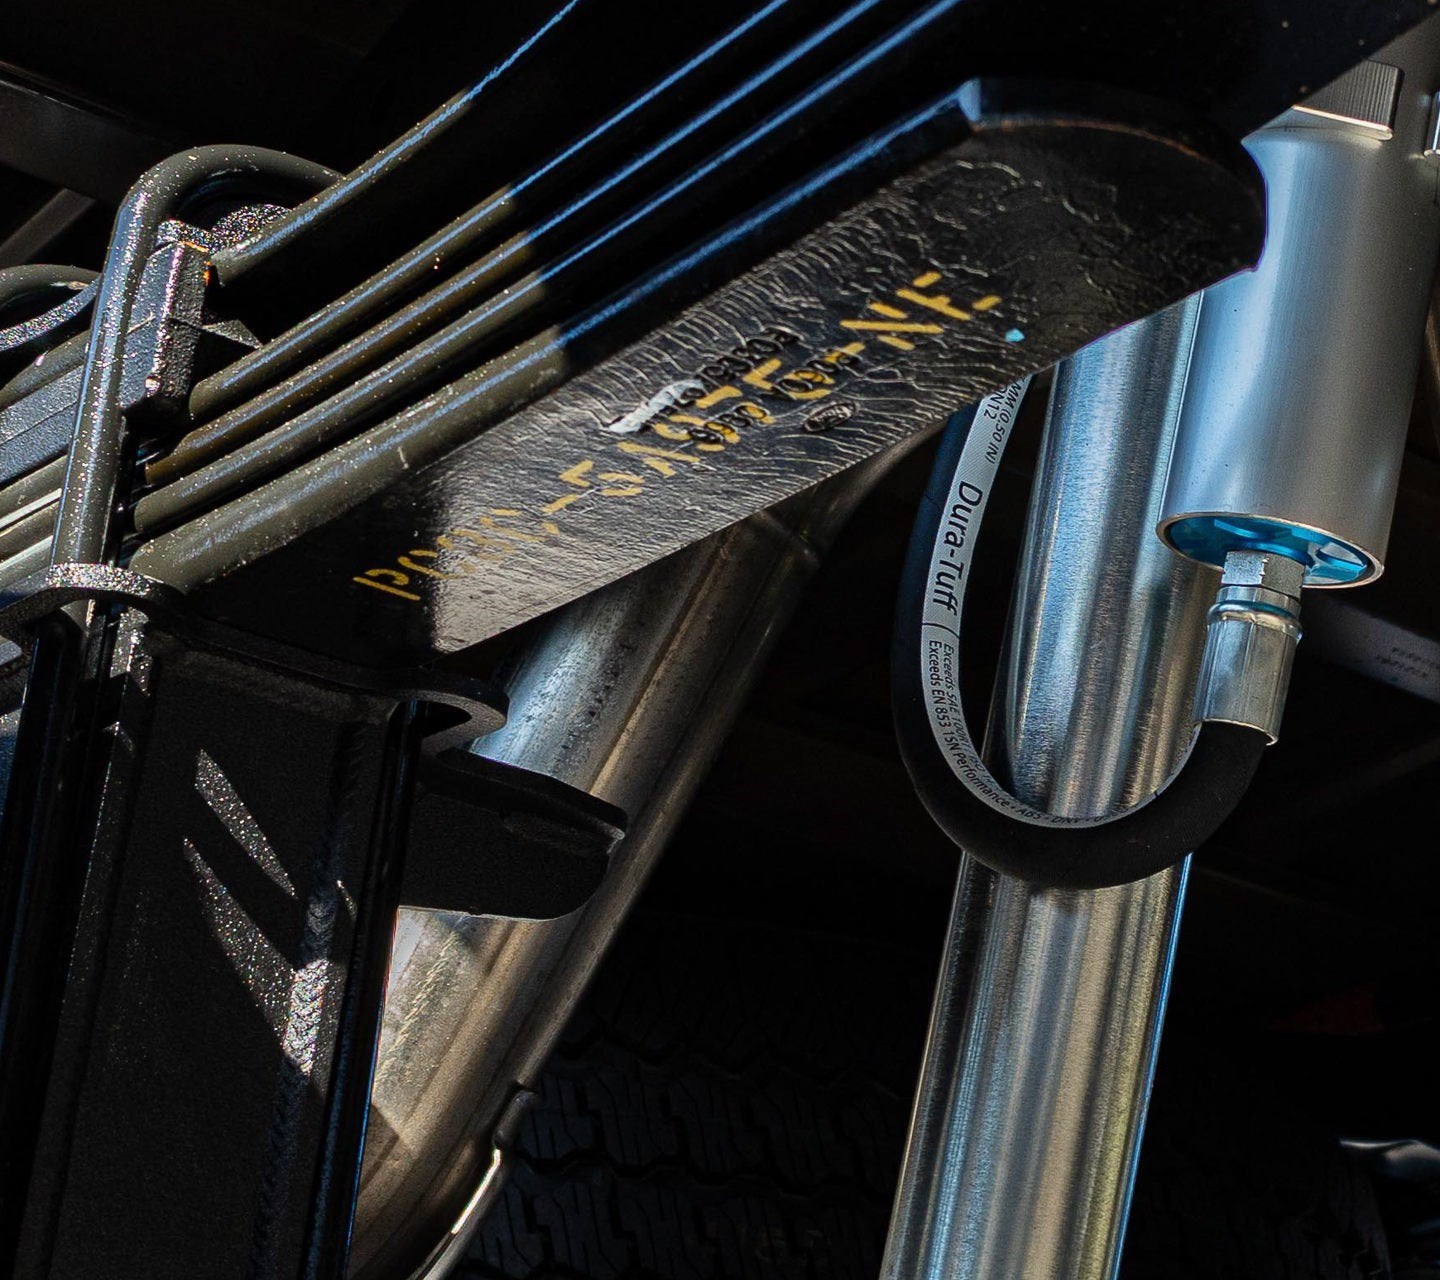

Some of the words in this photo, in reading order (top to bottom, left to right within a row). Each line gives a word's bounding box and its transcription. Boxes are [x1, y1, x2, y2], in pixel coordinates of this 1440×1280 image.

[995, 408, 1012, 443] (0.50
[985, 442, 1000, 464] IN)
[932, 480, 983, 616] Dura-Tuff
[929, 640, 944, 687] Exceeds
[943, 643, 956, 691] Exceeds
[931, 689, 947, 705] EN
[947, 692, 961, 716] SAE
[935, 707, 952, 728] 853
[953, 752, 1010, 807] Performance
